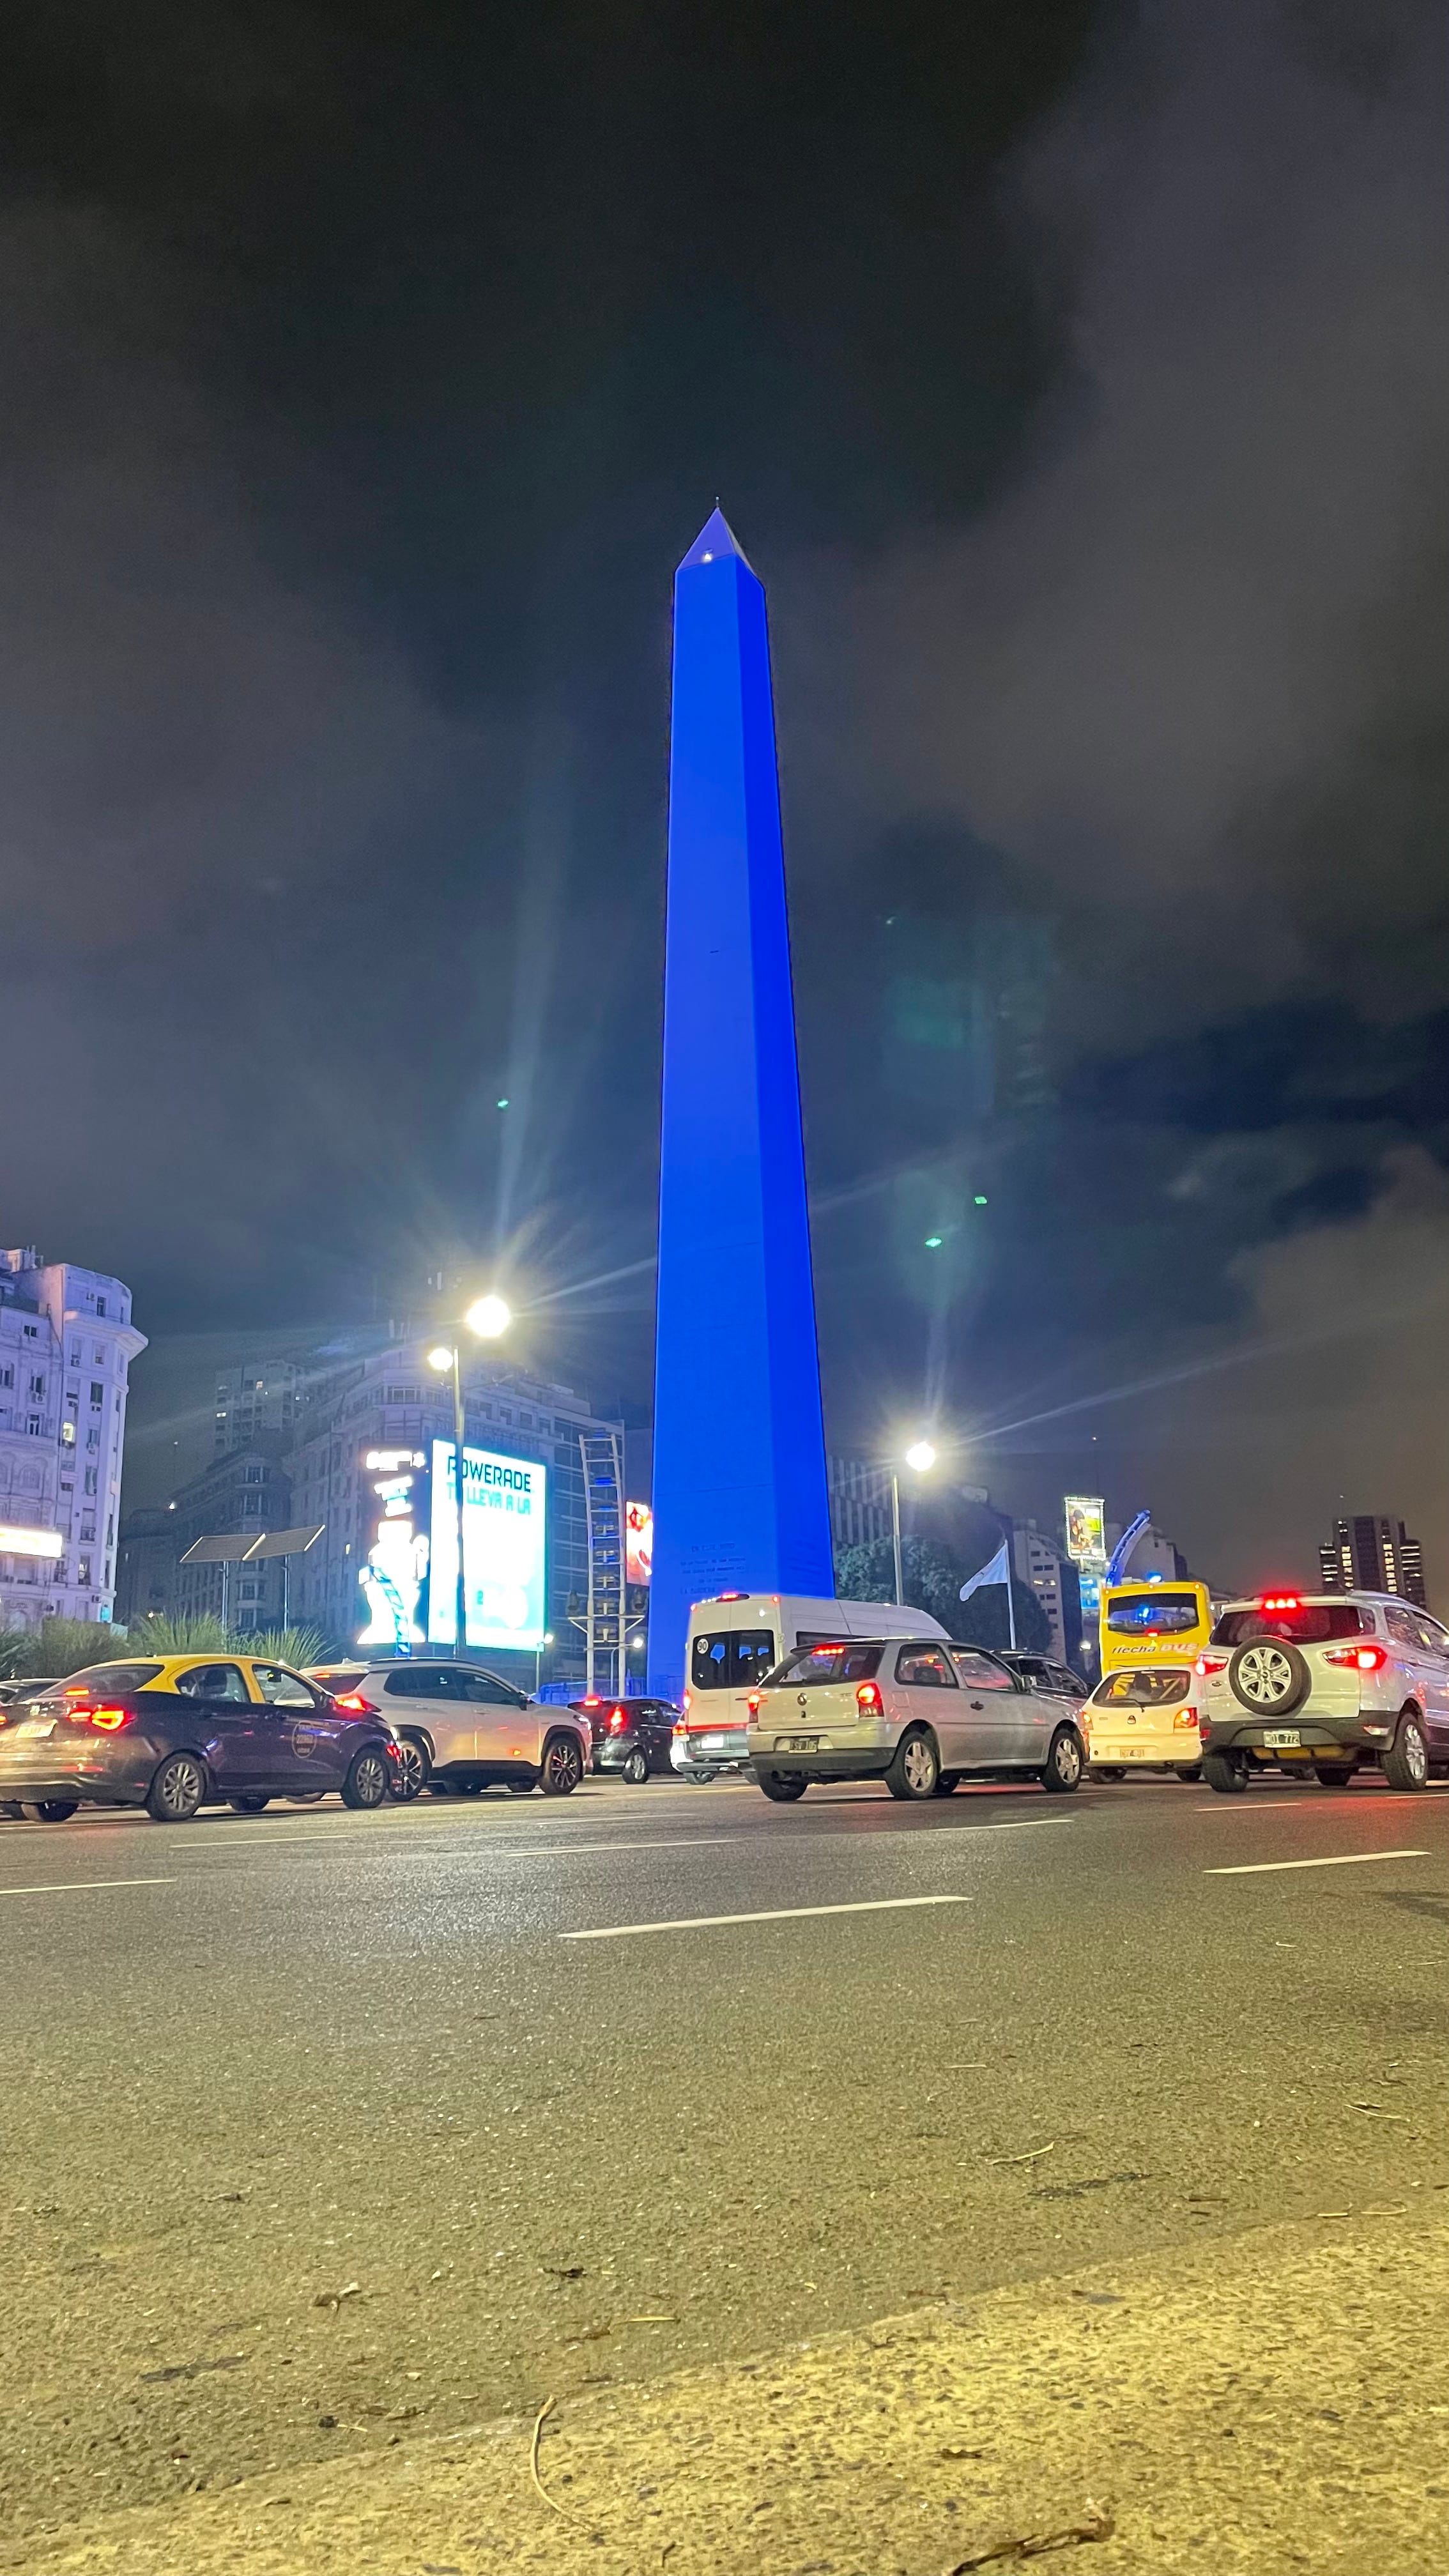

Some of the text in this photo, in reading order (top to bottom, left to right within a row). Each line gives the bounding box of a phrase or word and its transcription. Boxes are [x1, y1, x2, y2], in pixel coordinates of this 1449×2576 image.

[447, 1455, 531, 1493] POWERADE
[467, 1486, 502, 1509] LLEVA
[506, 1494, 514, 1512] A
[517, 1496, 532, 1515] LA
[698, 1641, 707, 1651] 90
[1160, 1643, 1199, 1652] BUS
[1284, 1733, 1299, 1744] 772
